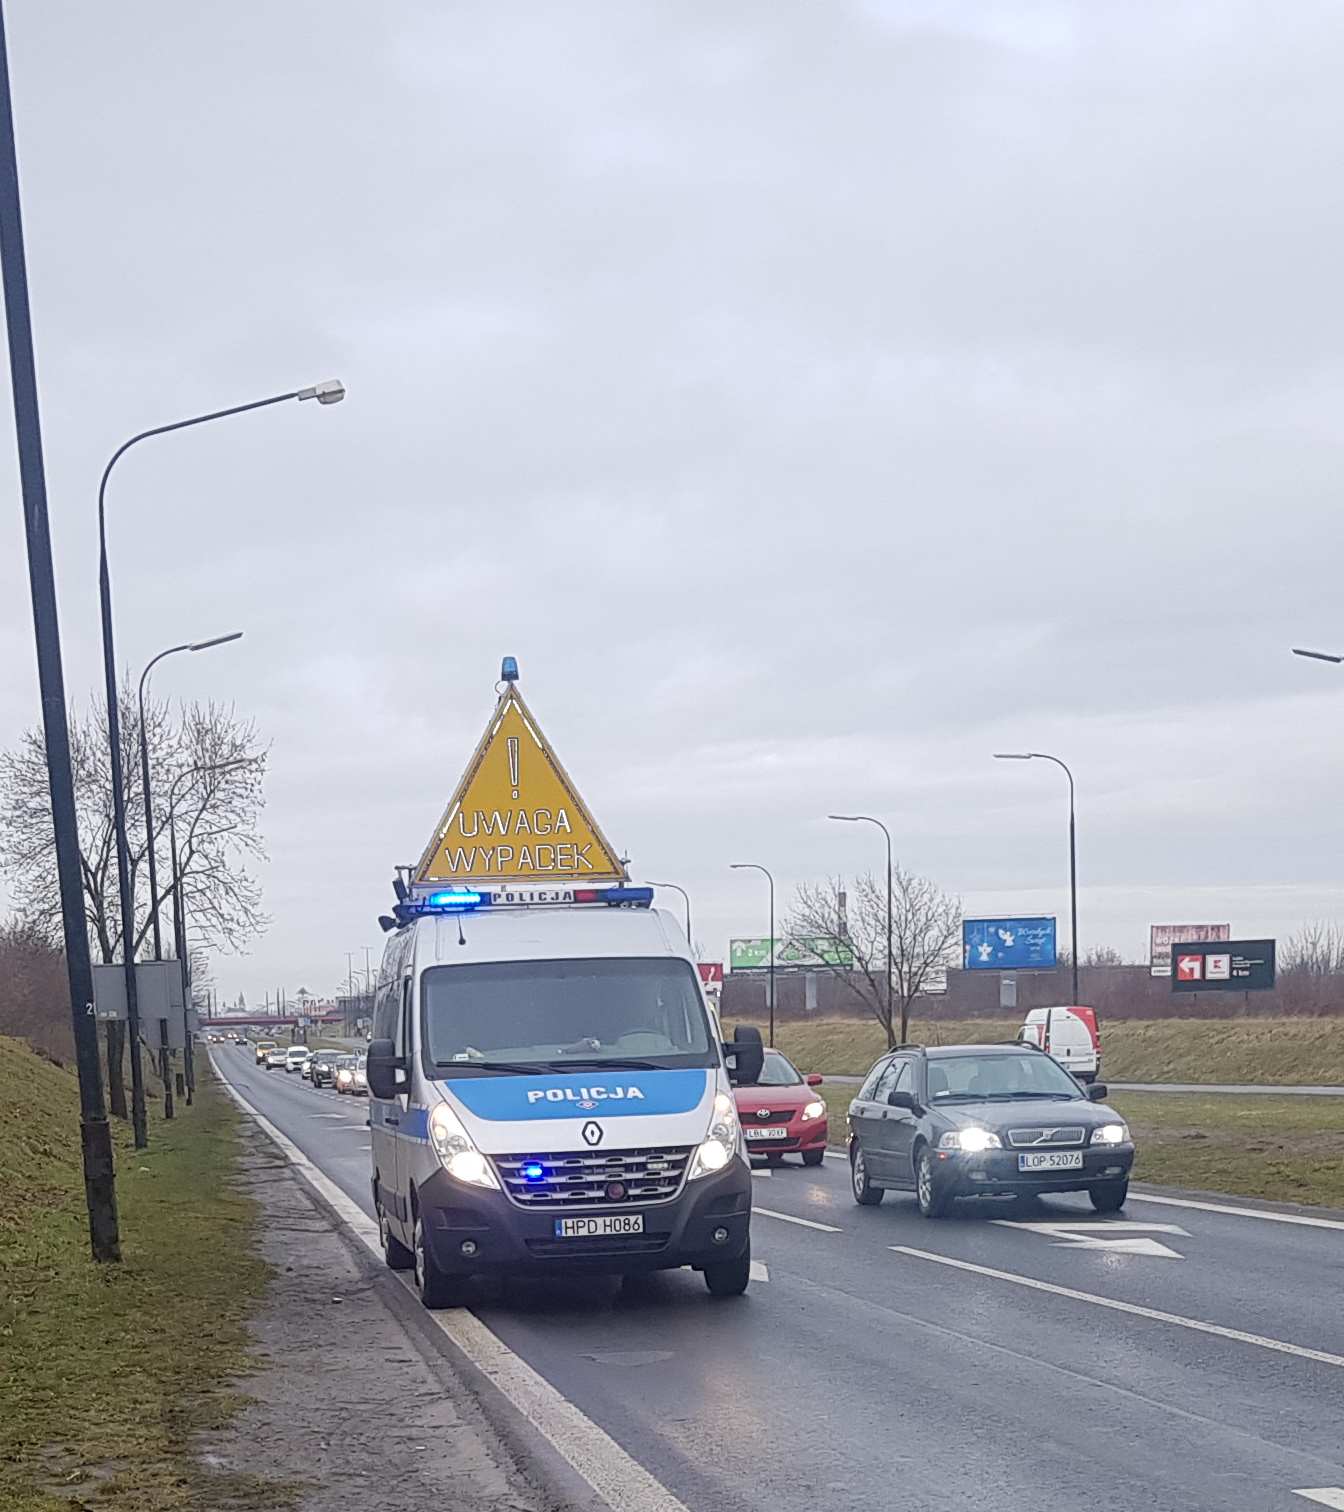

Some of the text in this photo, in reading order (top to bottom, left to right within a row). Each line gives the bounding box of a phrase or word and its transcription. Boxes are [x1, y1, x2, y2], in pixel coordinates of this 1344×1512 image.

[459, 808, 572, 837] UWAGA
[445, 843, 594, 872] WYPADEK
[493, 891, 572, 903] POLICJA
[86, 1002, 93, 1015] 2
[527, 1087, 645, 1104] POLICJA
[1026, 1153, 1081, 1167] LOP 52076
[564, 1217, 641, 1235] HPD H086
